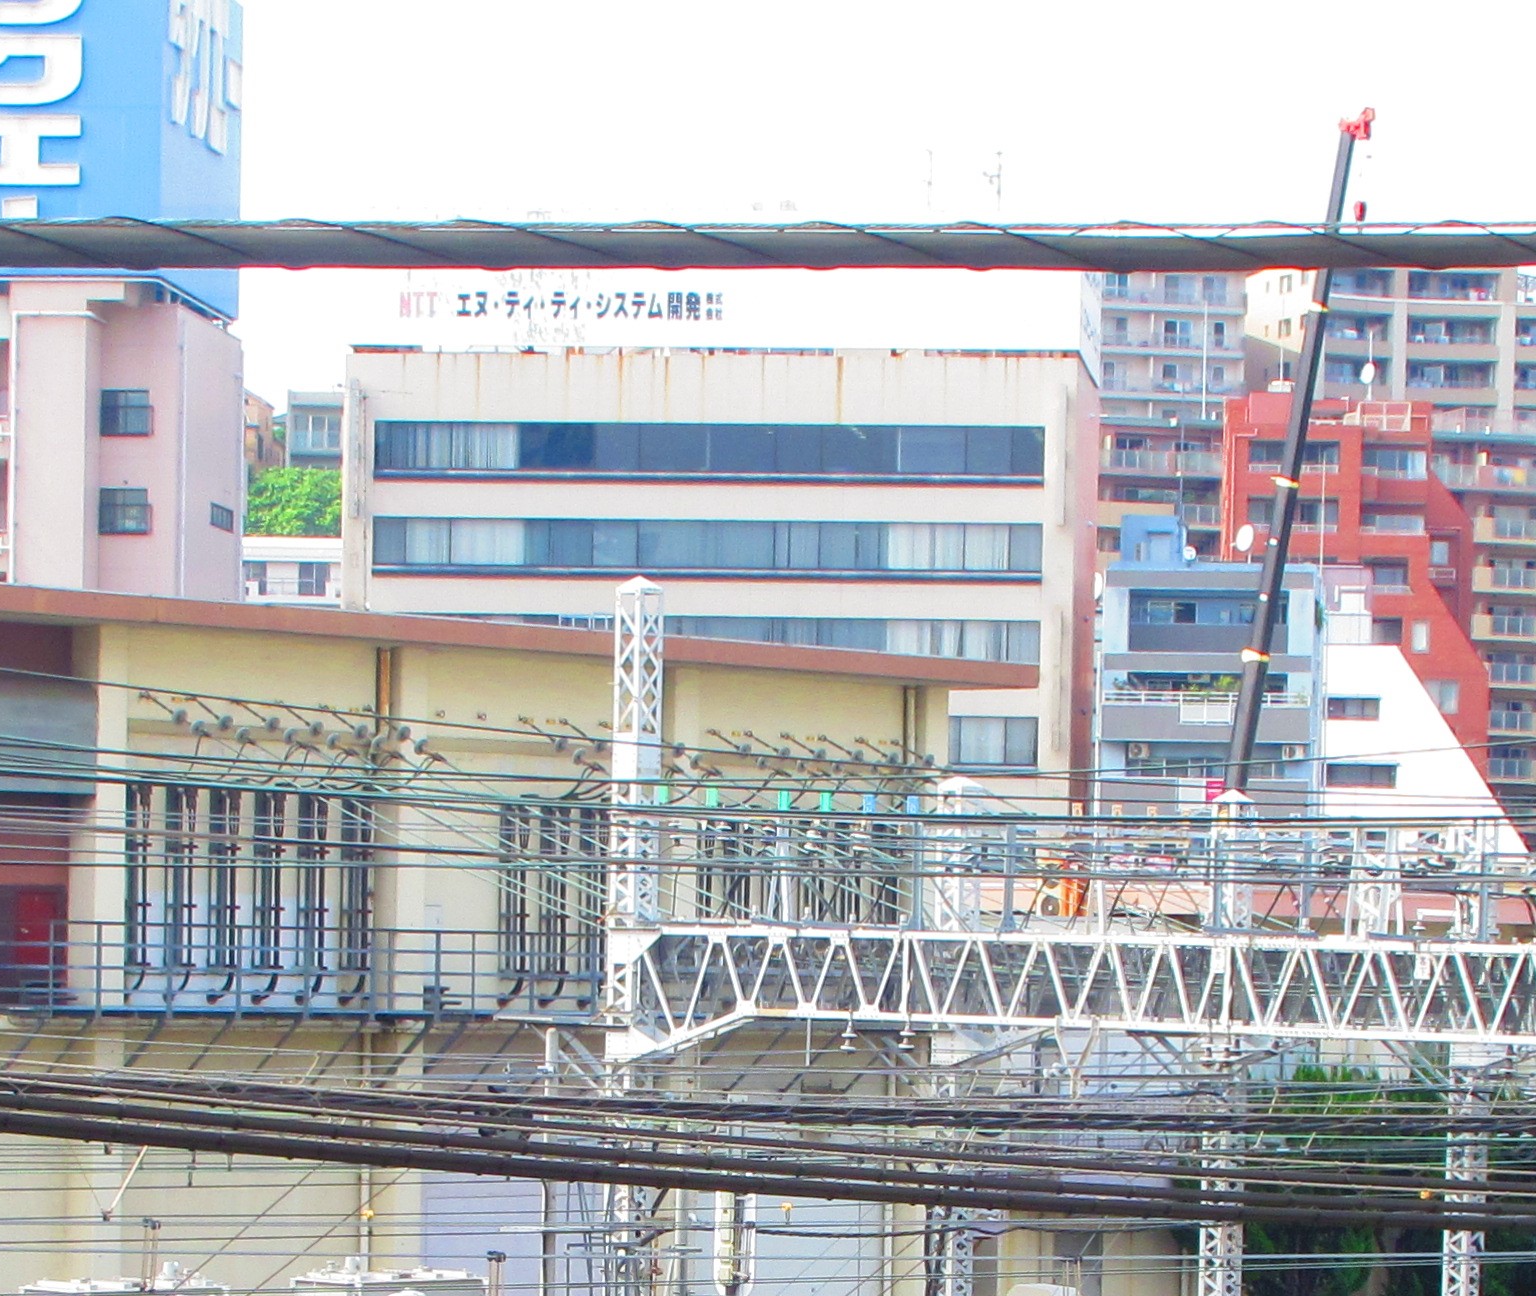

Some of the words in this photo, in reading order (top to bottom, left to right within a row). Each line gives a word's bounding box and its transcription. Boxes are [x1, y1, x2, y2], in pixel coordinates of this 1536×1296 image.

[457, 291, 702, 320] エヌ・ティ・ティ・システム開発
